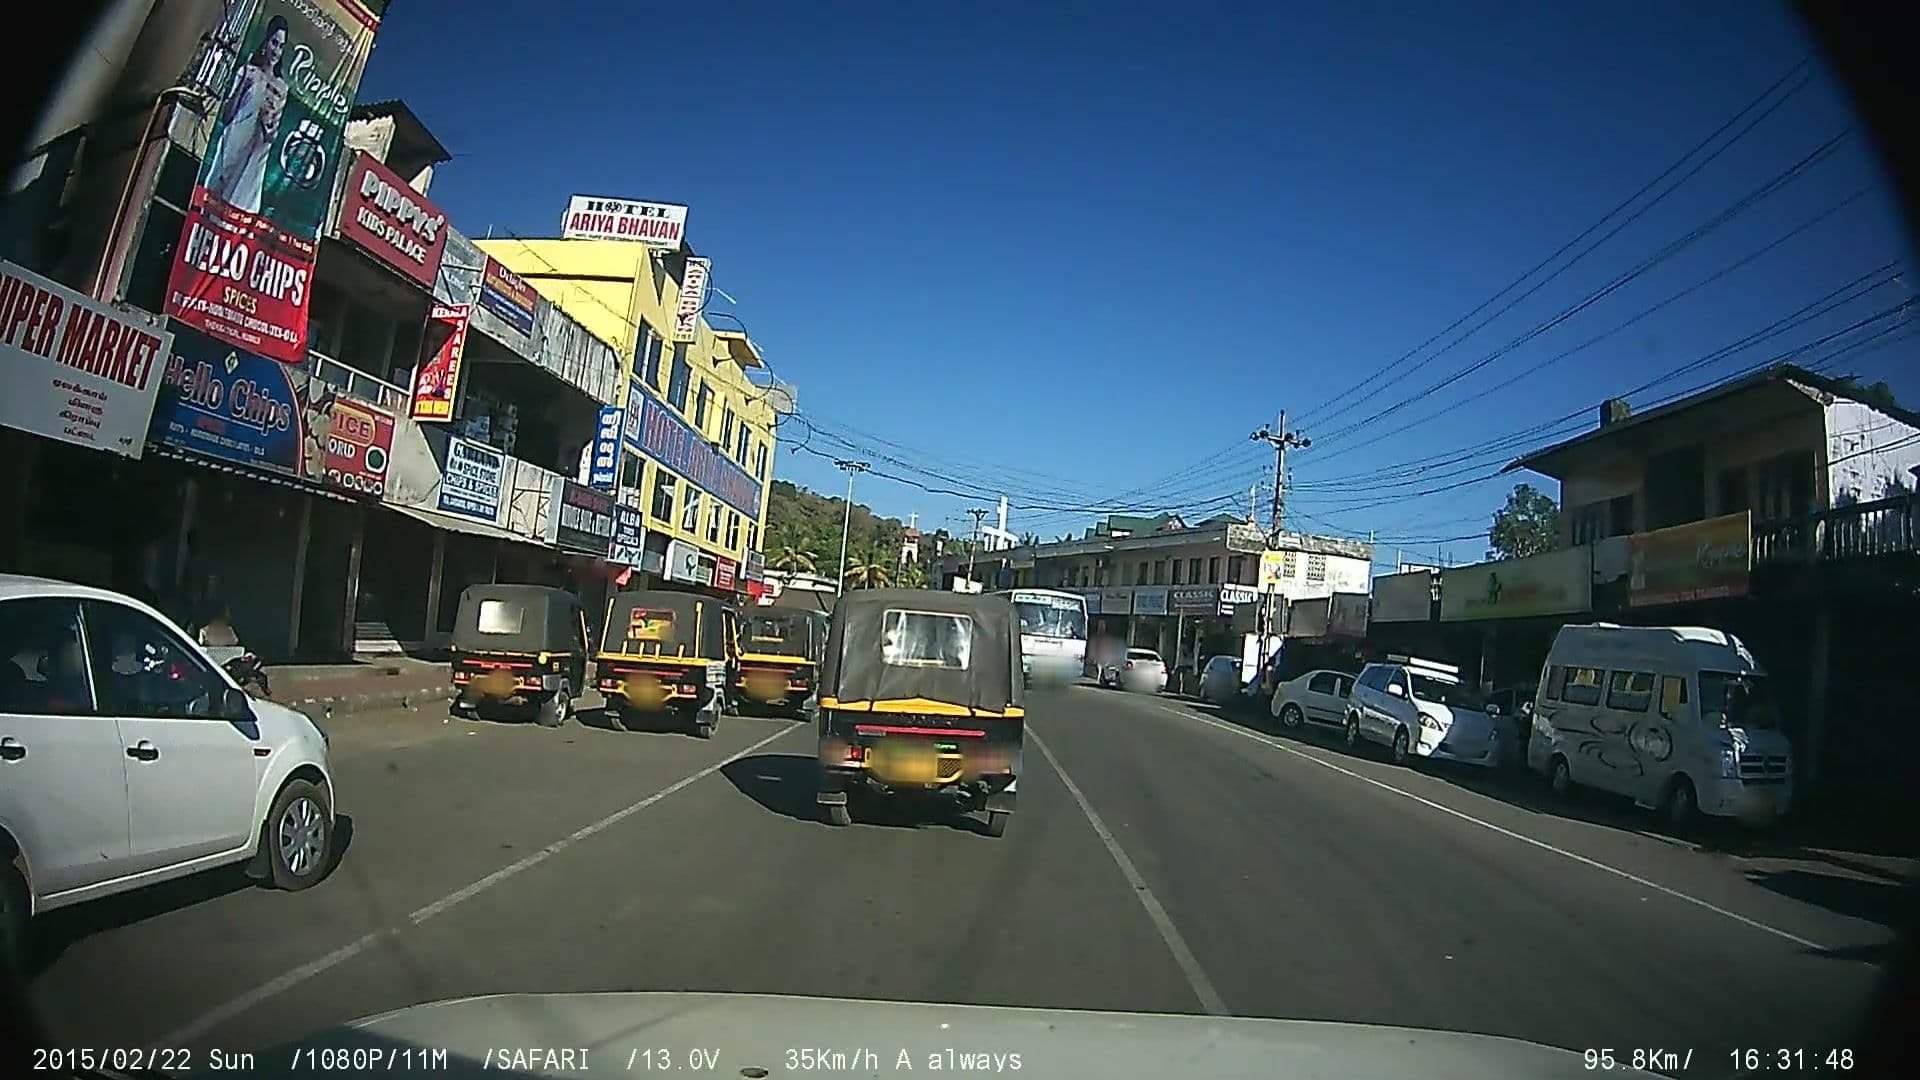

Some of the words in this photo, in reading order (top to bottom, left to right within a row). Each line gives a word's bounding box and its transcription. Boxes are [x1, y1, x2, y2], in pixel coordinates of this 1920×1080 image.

[357, 206, 386, 236] KIDS
[385, 225, 427, 264] PALACE
[569, 212, 614, 233] ARIYA
[617, 216, 680, 241] BHAVAN
[585, 200, 671, 219] HOTEL
[184, 222, 249, 281] HELLO
[249, 250, 307, 306] CHIPS
[0, 273, 64, 359] UPER
[56, 303, 163, 391] MARKET
[223, 286, 258, 314] SPICES
[444, 319, 464, 400] SAREES
[164, 353, 224, 410] Hello
[229, 378, 291, 436] Chips
